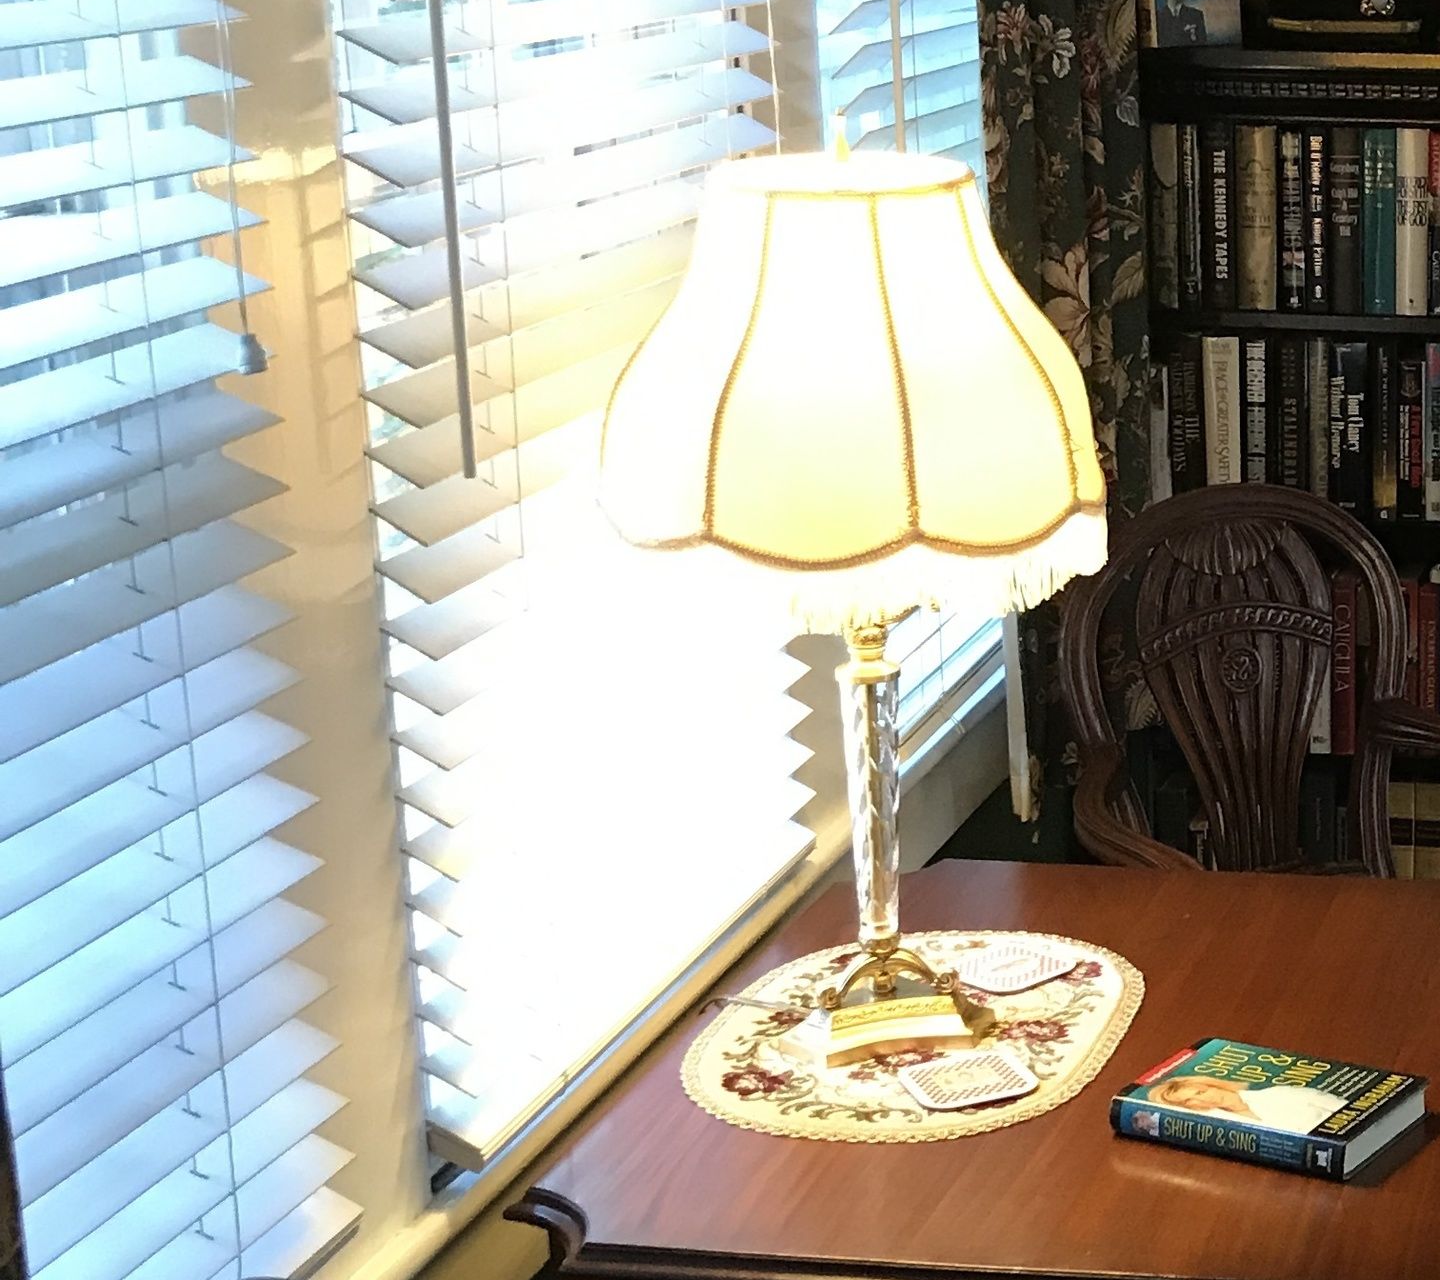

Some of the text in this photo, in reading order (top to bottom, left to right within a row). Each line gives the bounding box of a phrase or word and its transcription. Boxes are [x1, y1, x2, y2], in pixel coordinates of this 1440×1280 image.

[1213, 150, 1228, 279] THE KENNEDY TAPES
[1432, 251, 1440, 281] CAUSE
[1217, 400, 1229, 445] GREATER
[1330, 376, 1345, 469] Without Remorse
[1343, 392, 1364, 453] Tom Clancy
[1216, 446, 1230, 483] SAFETY
[1334, 604, 1351, 693] CALIGULA
[1427, 677, 1435, 709] GLORY
[1194, 1045, 1257, 1077] SHUT
[1231, 1052, 1297, 1084] UP &
[1271, 1060, 1332, 1088] SING
[1318, 1107, 1361, 1134] LAURA
[1352, 1074, 1408, 1111] INGRAHAM
[1163, 1117, 1257, 1154] SHUT UP & SING
